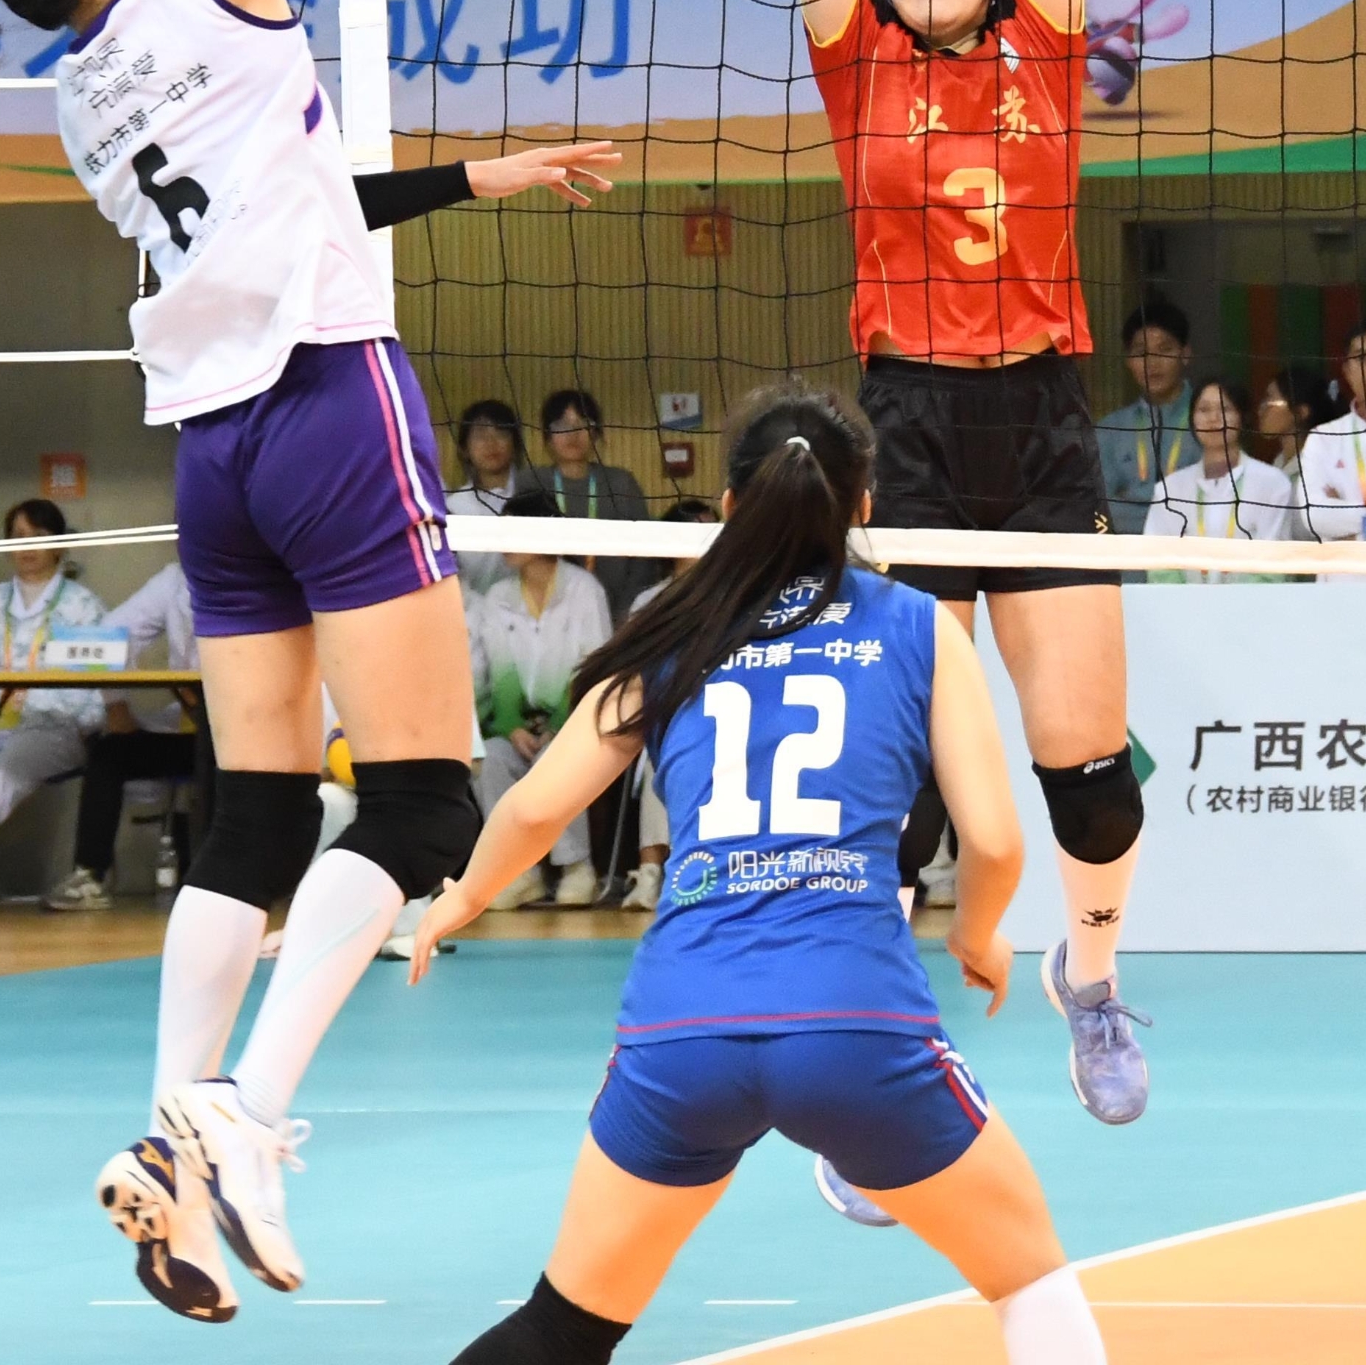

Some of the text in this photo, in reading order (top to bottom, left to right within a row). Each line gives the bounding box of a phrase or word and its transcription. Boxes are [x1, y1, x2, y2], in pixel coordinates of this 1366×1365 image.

[907, 85, 1041, 144] 江苏
[944, 166, 1009, 266] 3
[698, 674, 847, 841] 12
[726, 875, 869, 895] SORDOE GROUP
